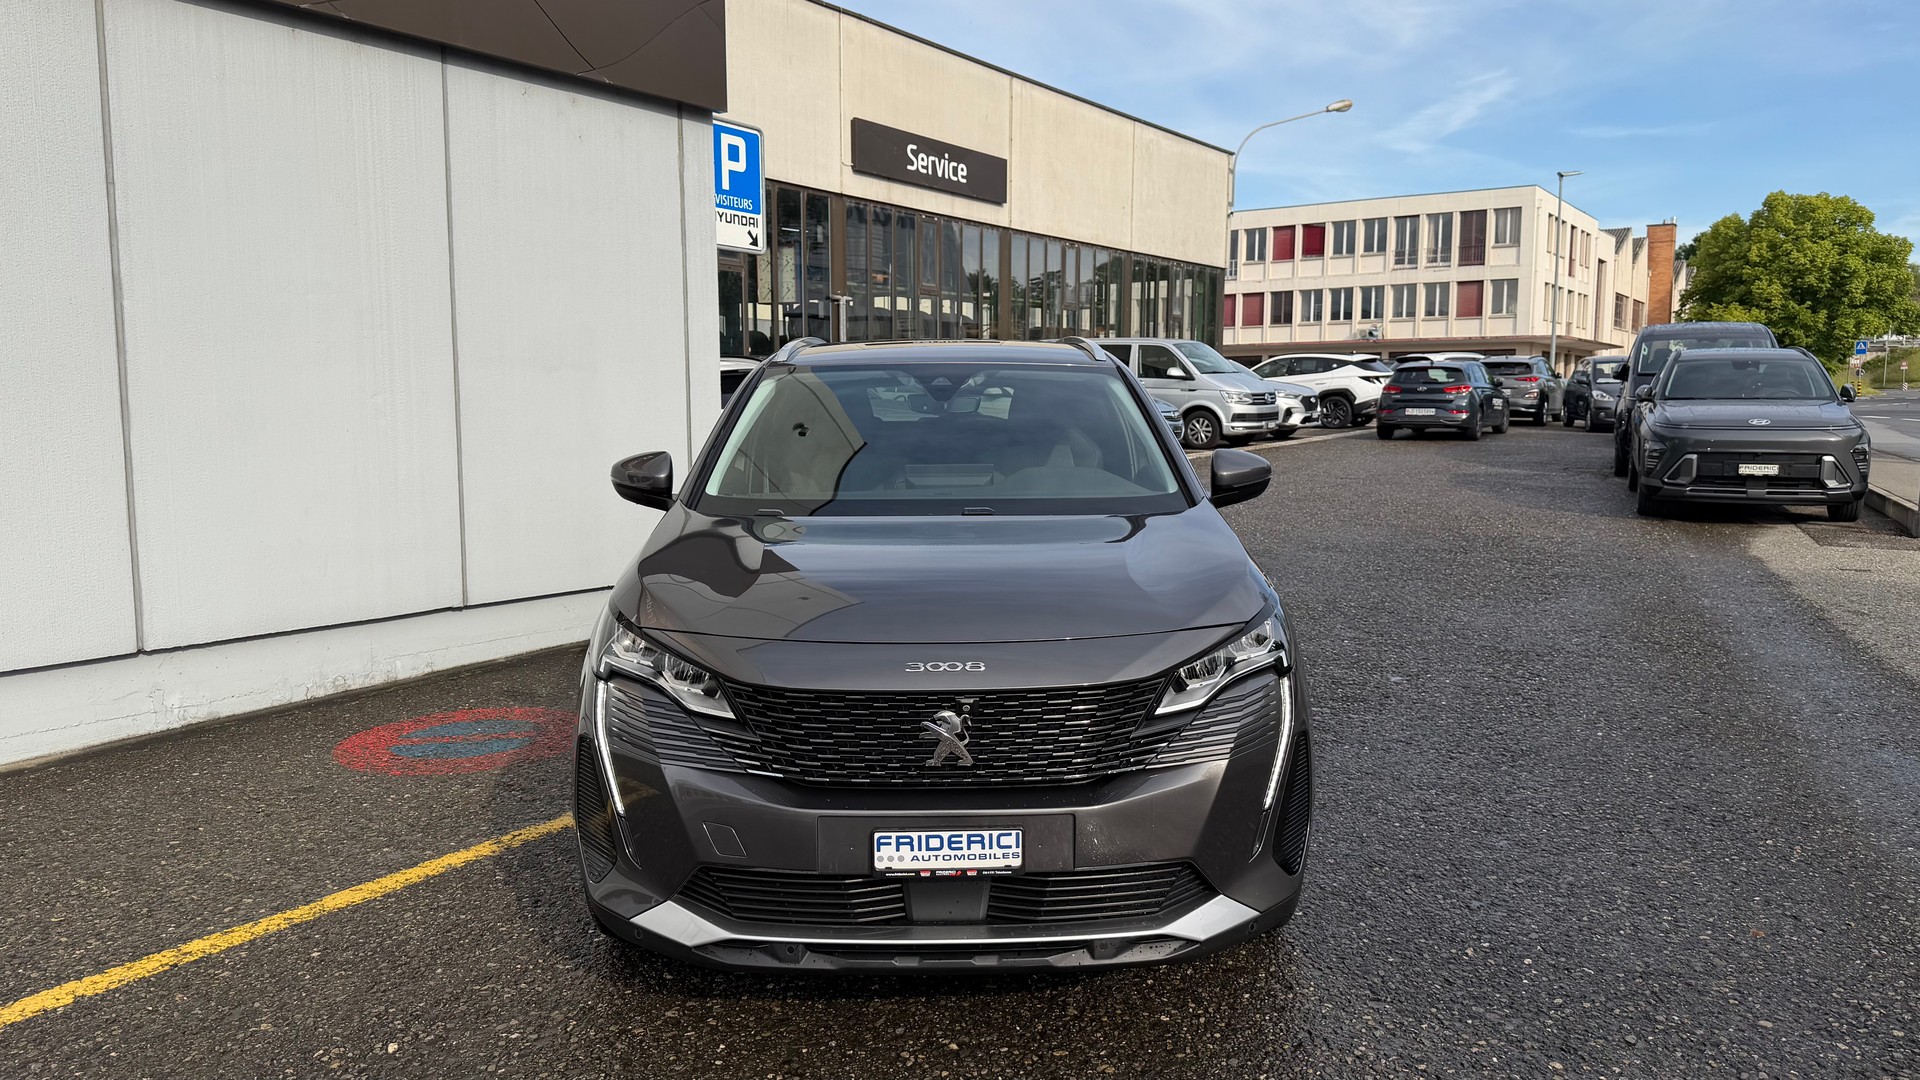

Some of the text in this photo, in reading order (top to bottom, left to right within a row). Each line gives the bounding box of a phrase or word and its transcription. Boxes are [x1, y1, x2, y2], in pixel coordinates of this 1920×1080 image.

[720, 132, 747, 191] P
[906, 143, 968, 184] Service
[715, 193, 753, 211] VISITEURS
[715, 211, 759, 229] YUNDAI
[905, 661, 986, 672] 3008
[876, 831, 1020, 853] FRIDERICI
[910, 852, 1020, 862] AUTOMOBILES
